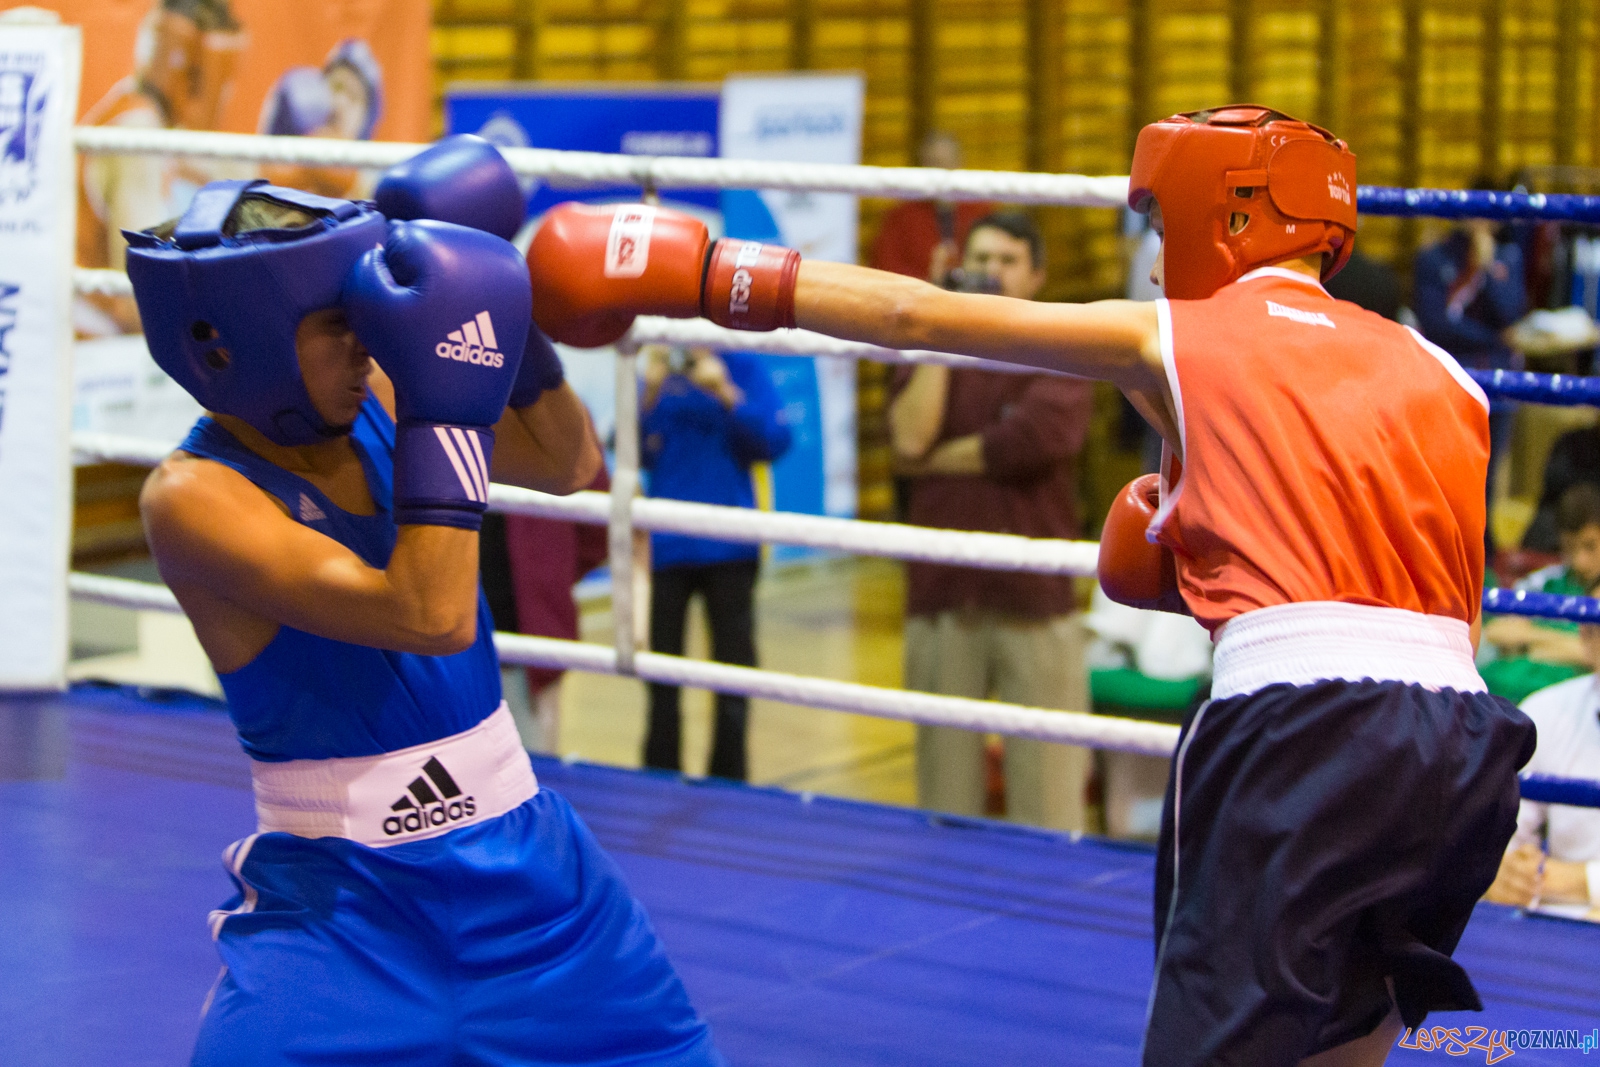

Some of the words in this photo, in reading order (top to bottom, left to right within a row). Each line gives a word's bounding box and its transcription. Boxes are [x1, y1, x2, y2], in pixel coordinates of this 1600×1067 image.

[1285, 223, 1296, 235] M
[435, 341, 505, 368] adidas
[383, 796, 476, 836] adidas
